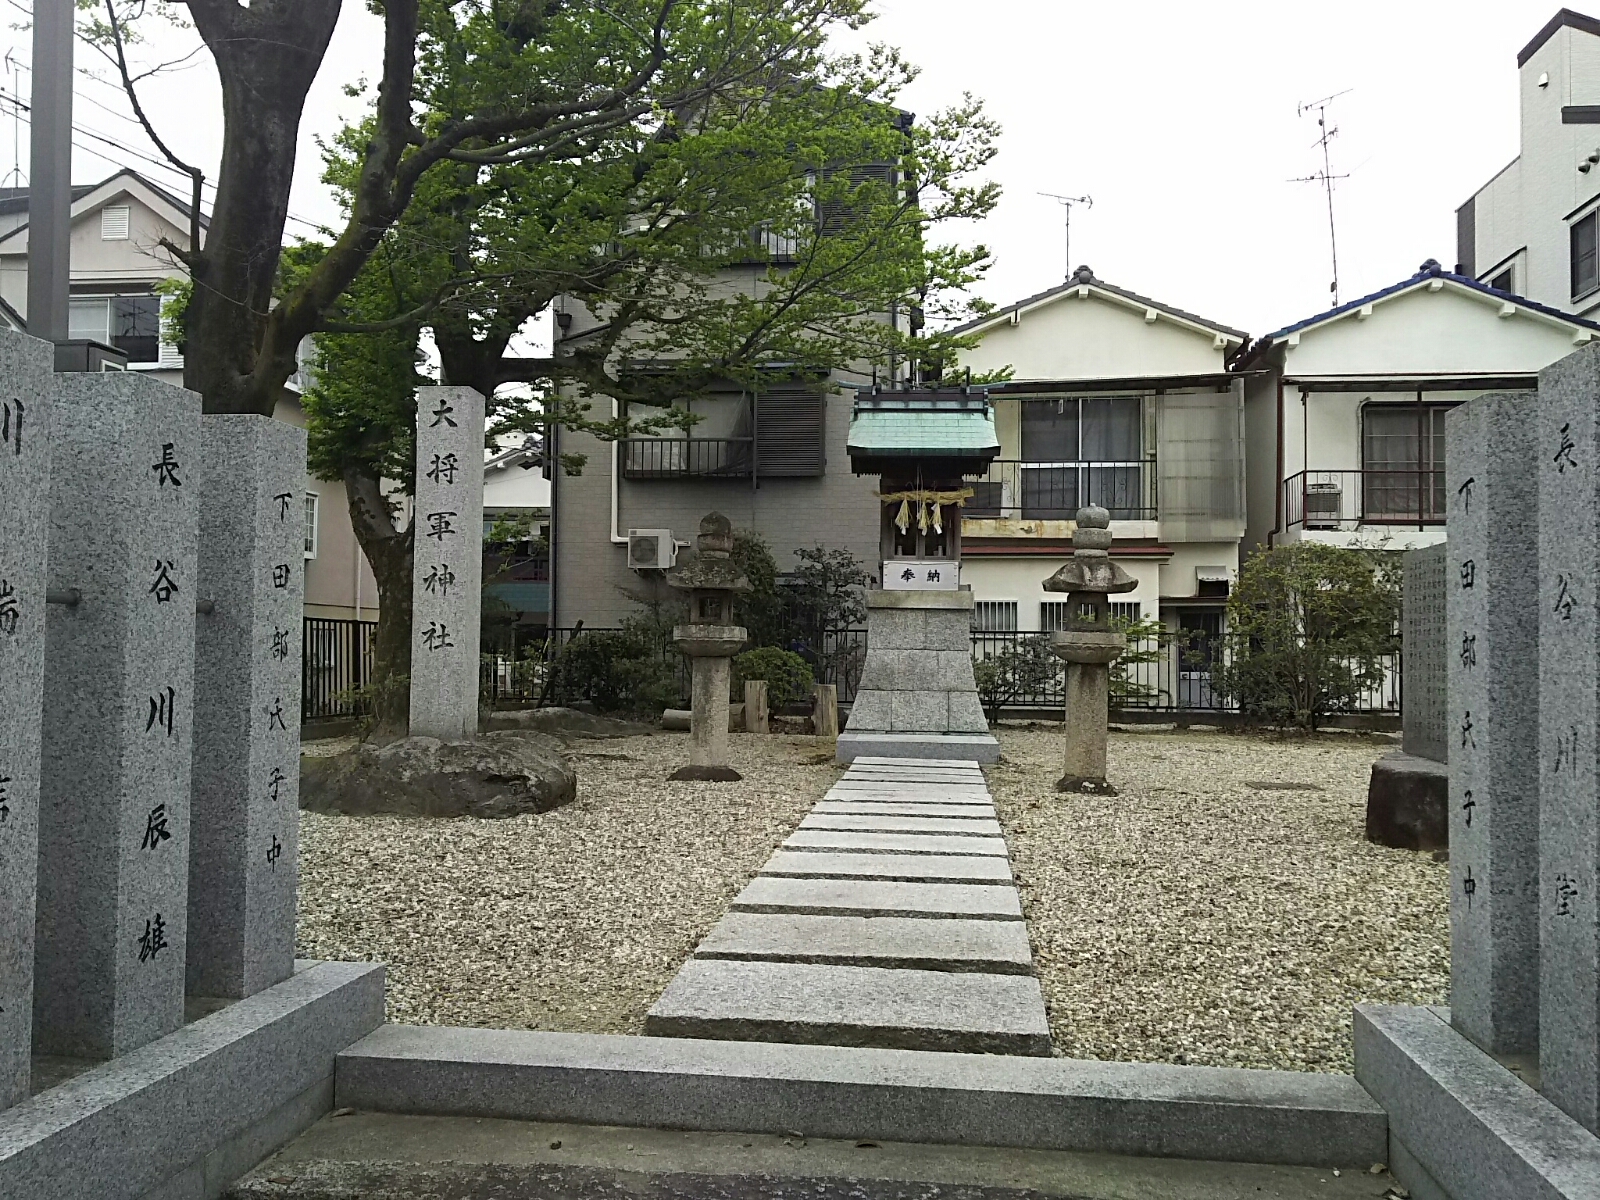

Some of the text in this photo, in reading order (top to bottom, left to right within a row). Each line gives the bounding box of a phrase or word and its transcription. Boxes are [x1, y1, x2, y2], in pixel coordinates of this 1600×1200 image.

[137, 442, 182, 964] 長谷川辰雄
[265, 491, 293, 874] 下田部氏子中
[421, 398, 459, 652] 大将軍神社
[900, 567, 941, 583] 奉納
[1458, 476, 1477, 911] 下田部氏子中
